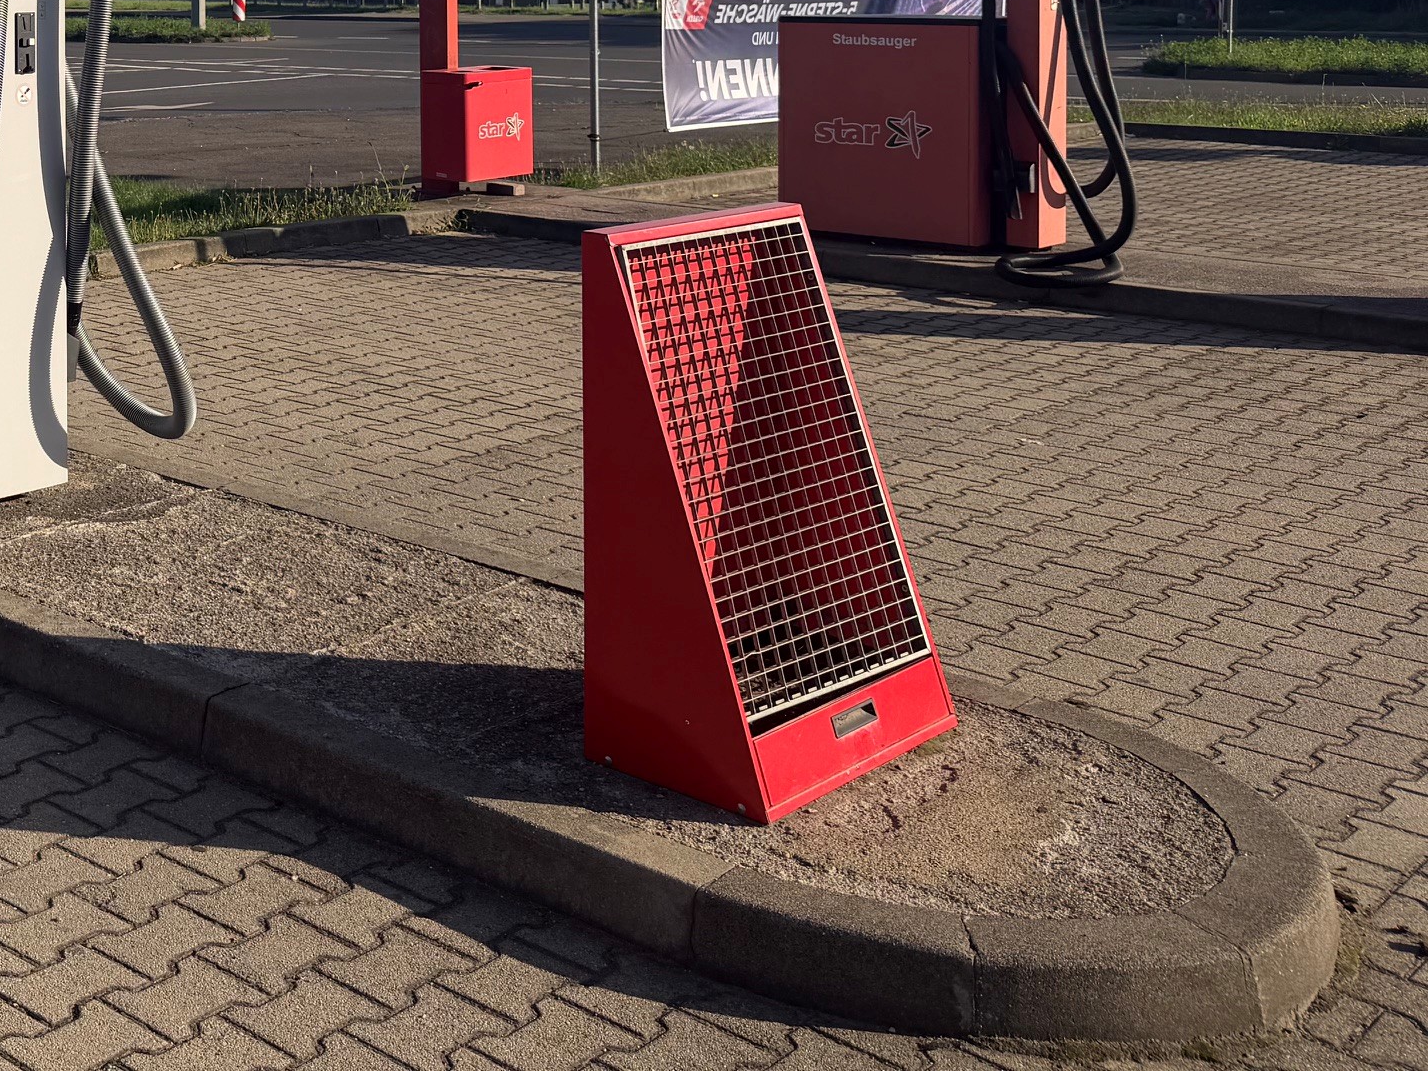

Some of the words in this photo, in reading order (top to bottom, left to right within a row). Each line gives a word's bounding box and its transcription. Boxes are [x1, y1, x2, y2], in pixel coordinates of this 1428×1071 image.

[832, 33, 917, 49] Staubsauger
[478, 120, 506, 139] star
[814, 117, 880, 146] star
